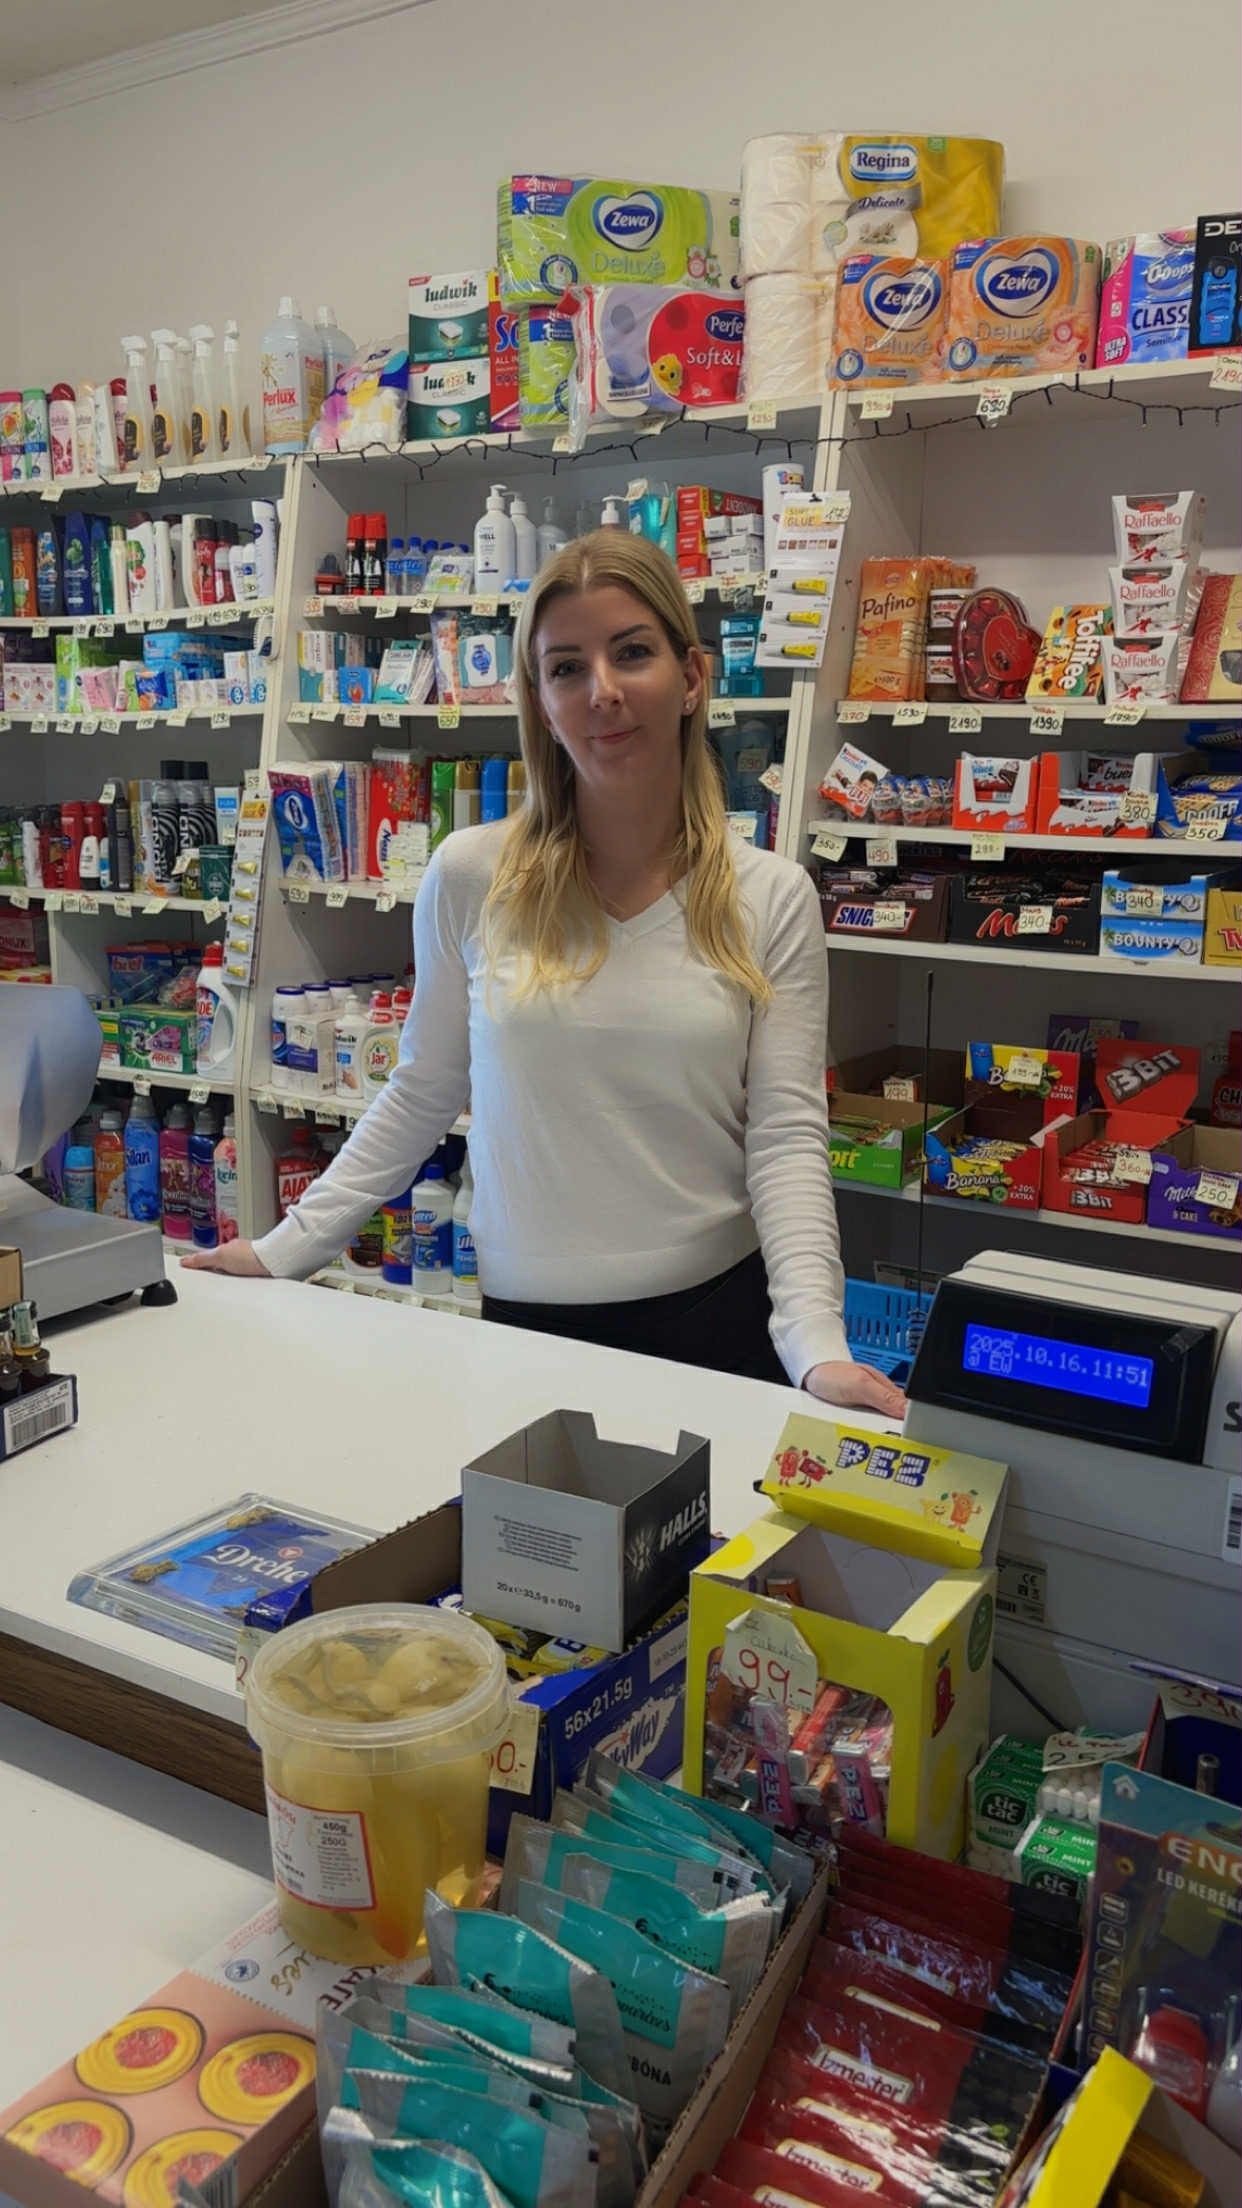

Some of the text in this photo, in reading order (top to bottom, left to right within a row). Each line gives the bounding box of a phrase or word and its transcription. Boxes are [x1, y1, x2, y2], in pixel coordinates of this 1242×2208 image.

[856, 151, 910, 171] Regina
[859, 195, 905, 209] Delicate
[611, 211, 651, 228] Zewa
[996, 270, 1041, 291] Zewa
[425, 279, 478, 303] ludwik
[882, 288, 924, 307] Zewa
[709, 314, 745, 334] Perfe
[1131, 304, 1189, 331] CLASS
[1124, 512, 1182, 530] Raffaello
[1119, 585, 1177, 601] Raffaello
[861, 593, 917, 621] Pafino
[1058, 610, 1104, 691] Toffifee
[1109, 654, 1166, 669] Raffaello
[1104, 767, 1134, 782] buen
[1114, 933, 1179, 949] BOUNTY
[151, 1052, 178, 1066] ARIEL
[371, 1051, 388, 1066] Jar
[945, 1171, 1001, 1191] Banana
[1164, 1185, 1197, 1202] Milk
[836, 1436, 932, 1488] PEZ
[659, 1491, 708, 1552] HALLS
[200, 1543, 310, 1585] Drehe
[563, 1677, 633, 1740] 56x21.5g
[761, 1760, 784, 1814] PEZ
[840, 1764, 869, 1822] PEZ
[987, 1803, 1018, 1823] tac
[995, 1795, 1021, 1814] tic
[1071, 1835, 1097, 1847] MIN
[1043, 1873, 1074, 1893] tic
[1157, 1867, 1186, 1891] LED
